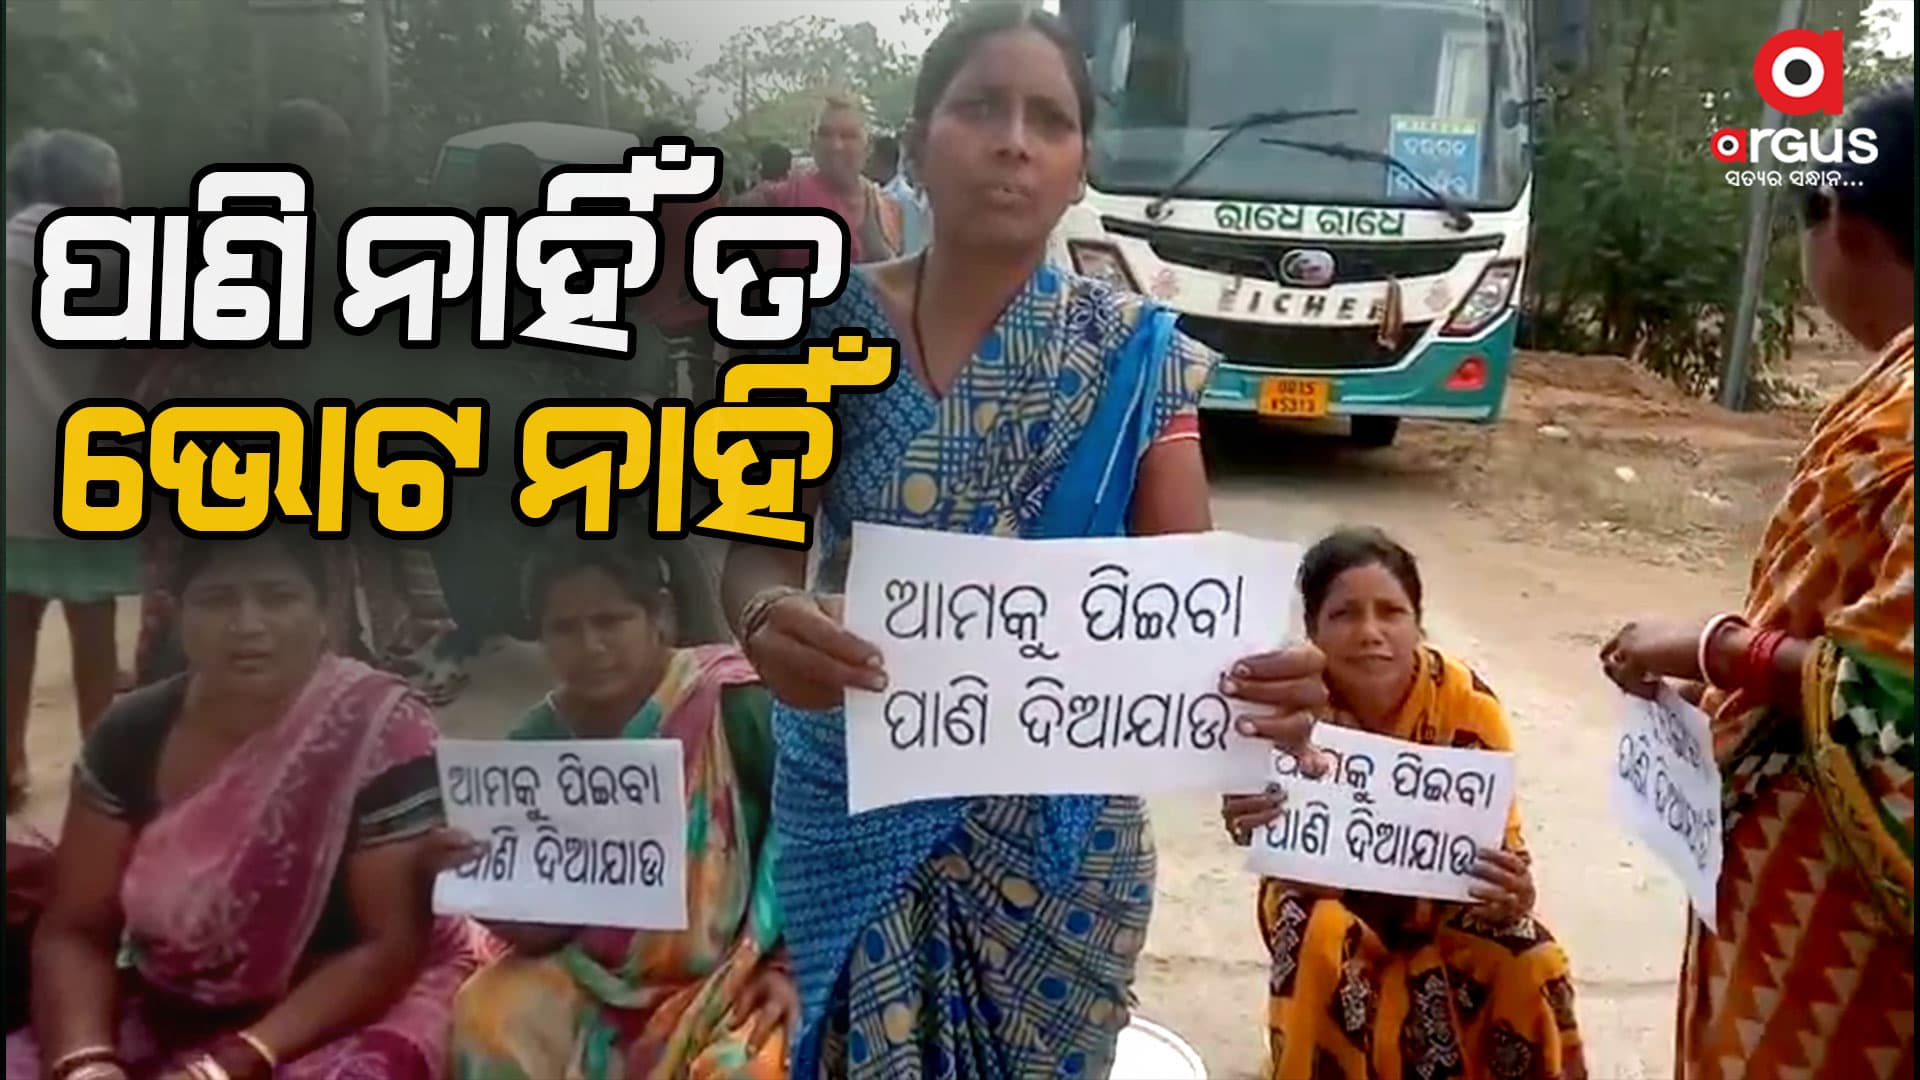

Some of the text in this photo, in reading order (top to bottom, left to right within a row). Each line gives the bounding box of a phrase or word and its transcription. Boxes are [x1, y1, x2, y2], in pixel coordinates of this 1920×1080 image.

[1214, 202, 1405, 237] ରାଧେ ରାଧେ
[884, 563, 1244, 660] ଆମକୁ ପିଇବା
[883, 675, 1232, 752] ପାଣି ଦିଆଯାଉ
[448, 752, 661, 822] ଆମକୁ ପିଇବା
[1392, 752, 1496, 810] ପିଇବା
[534, 826, 666, 888] ଦିଆଯାଉ
